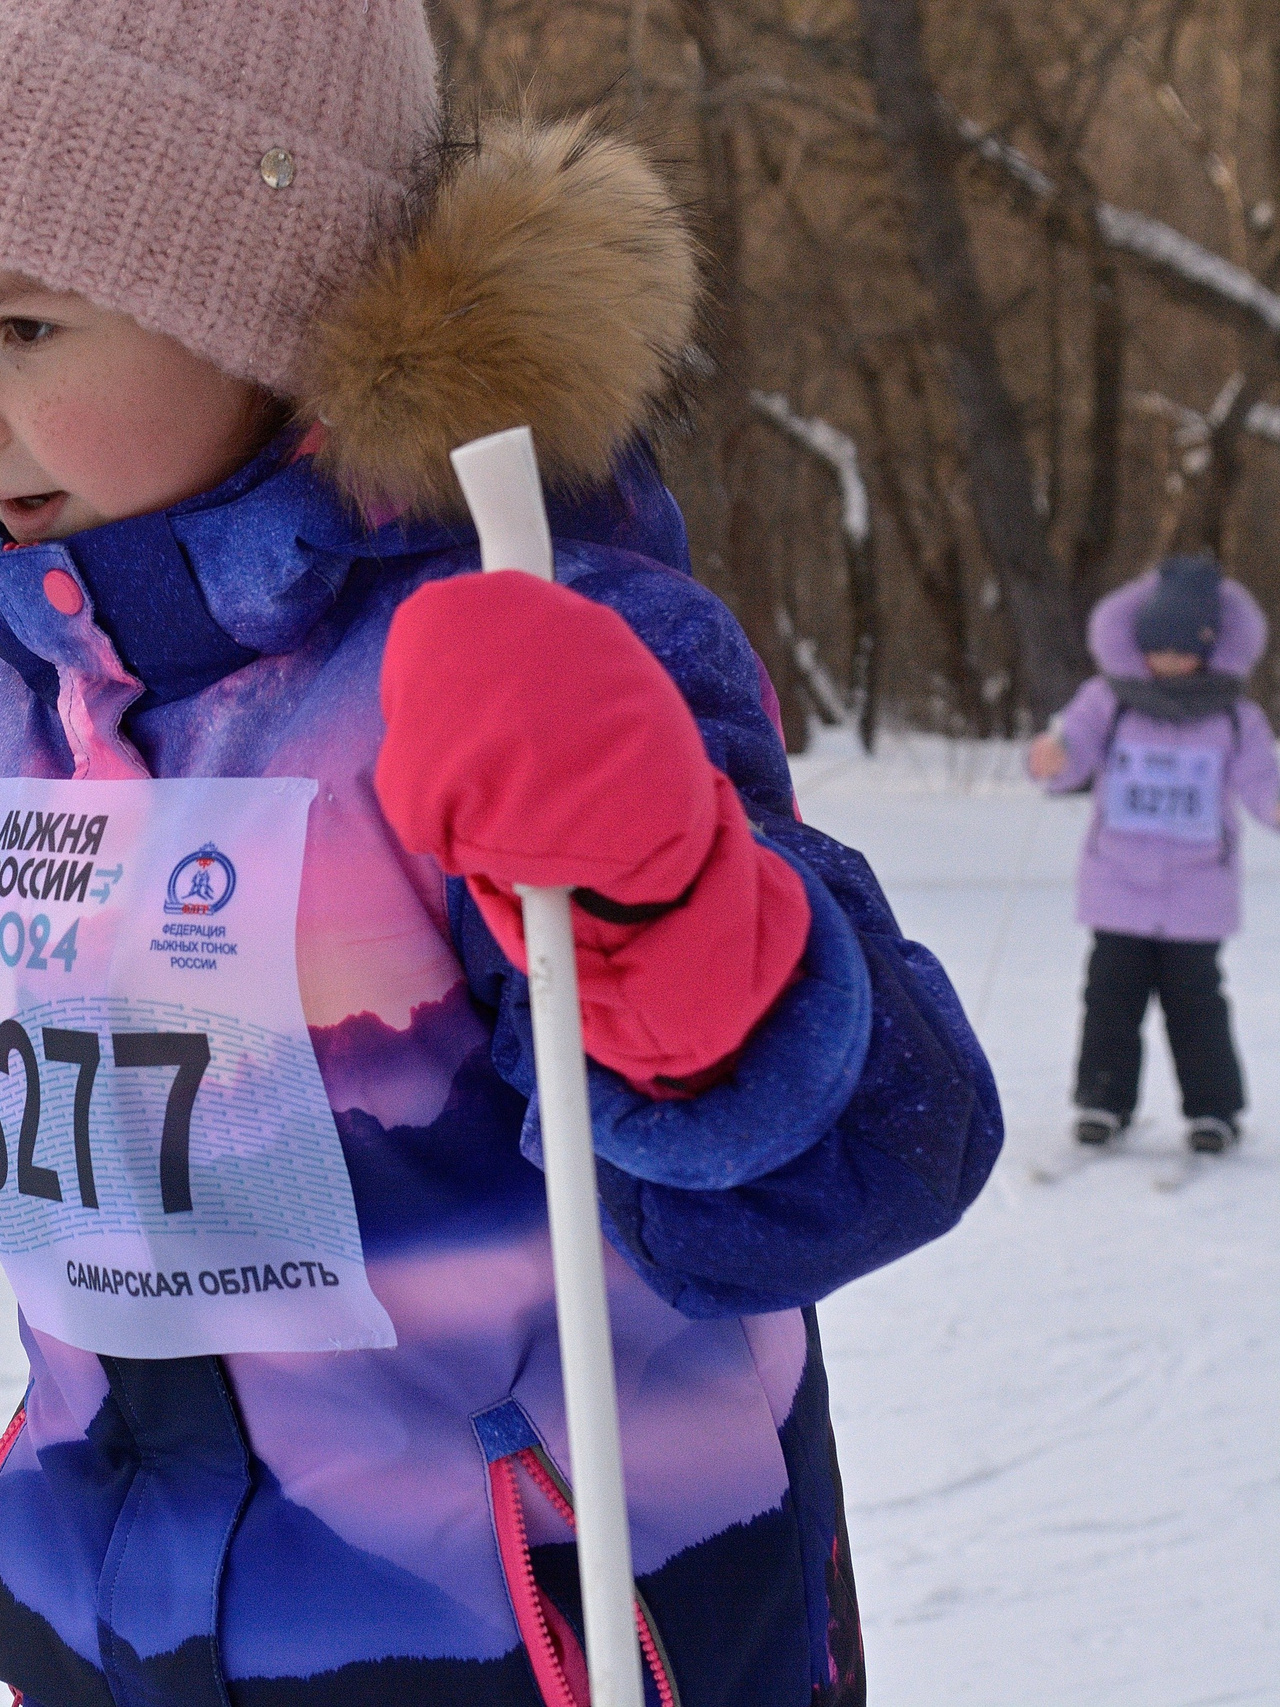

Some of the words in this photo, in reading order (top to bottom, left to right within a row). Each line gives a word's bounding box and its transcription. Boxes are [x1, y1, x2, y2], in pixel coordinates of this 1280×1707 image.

[162, 924, 226, 938] ФЕДЕРАЦИЯ
[150, 939, 199, 953] ЛЫЖНЫХ
[201, 941, 238, 955] ГОНОК
[170, 957, 217, 970] РОССИИ
[67, 1260, 193, 1297] САМАРСКАЯ
[198, 1261, 340, 1296] ОБЛАСТЬ
